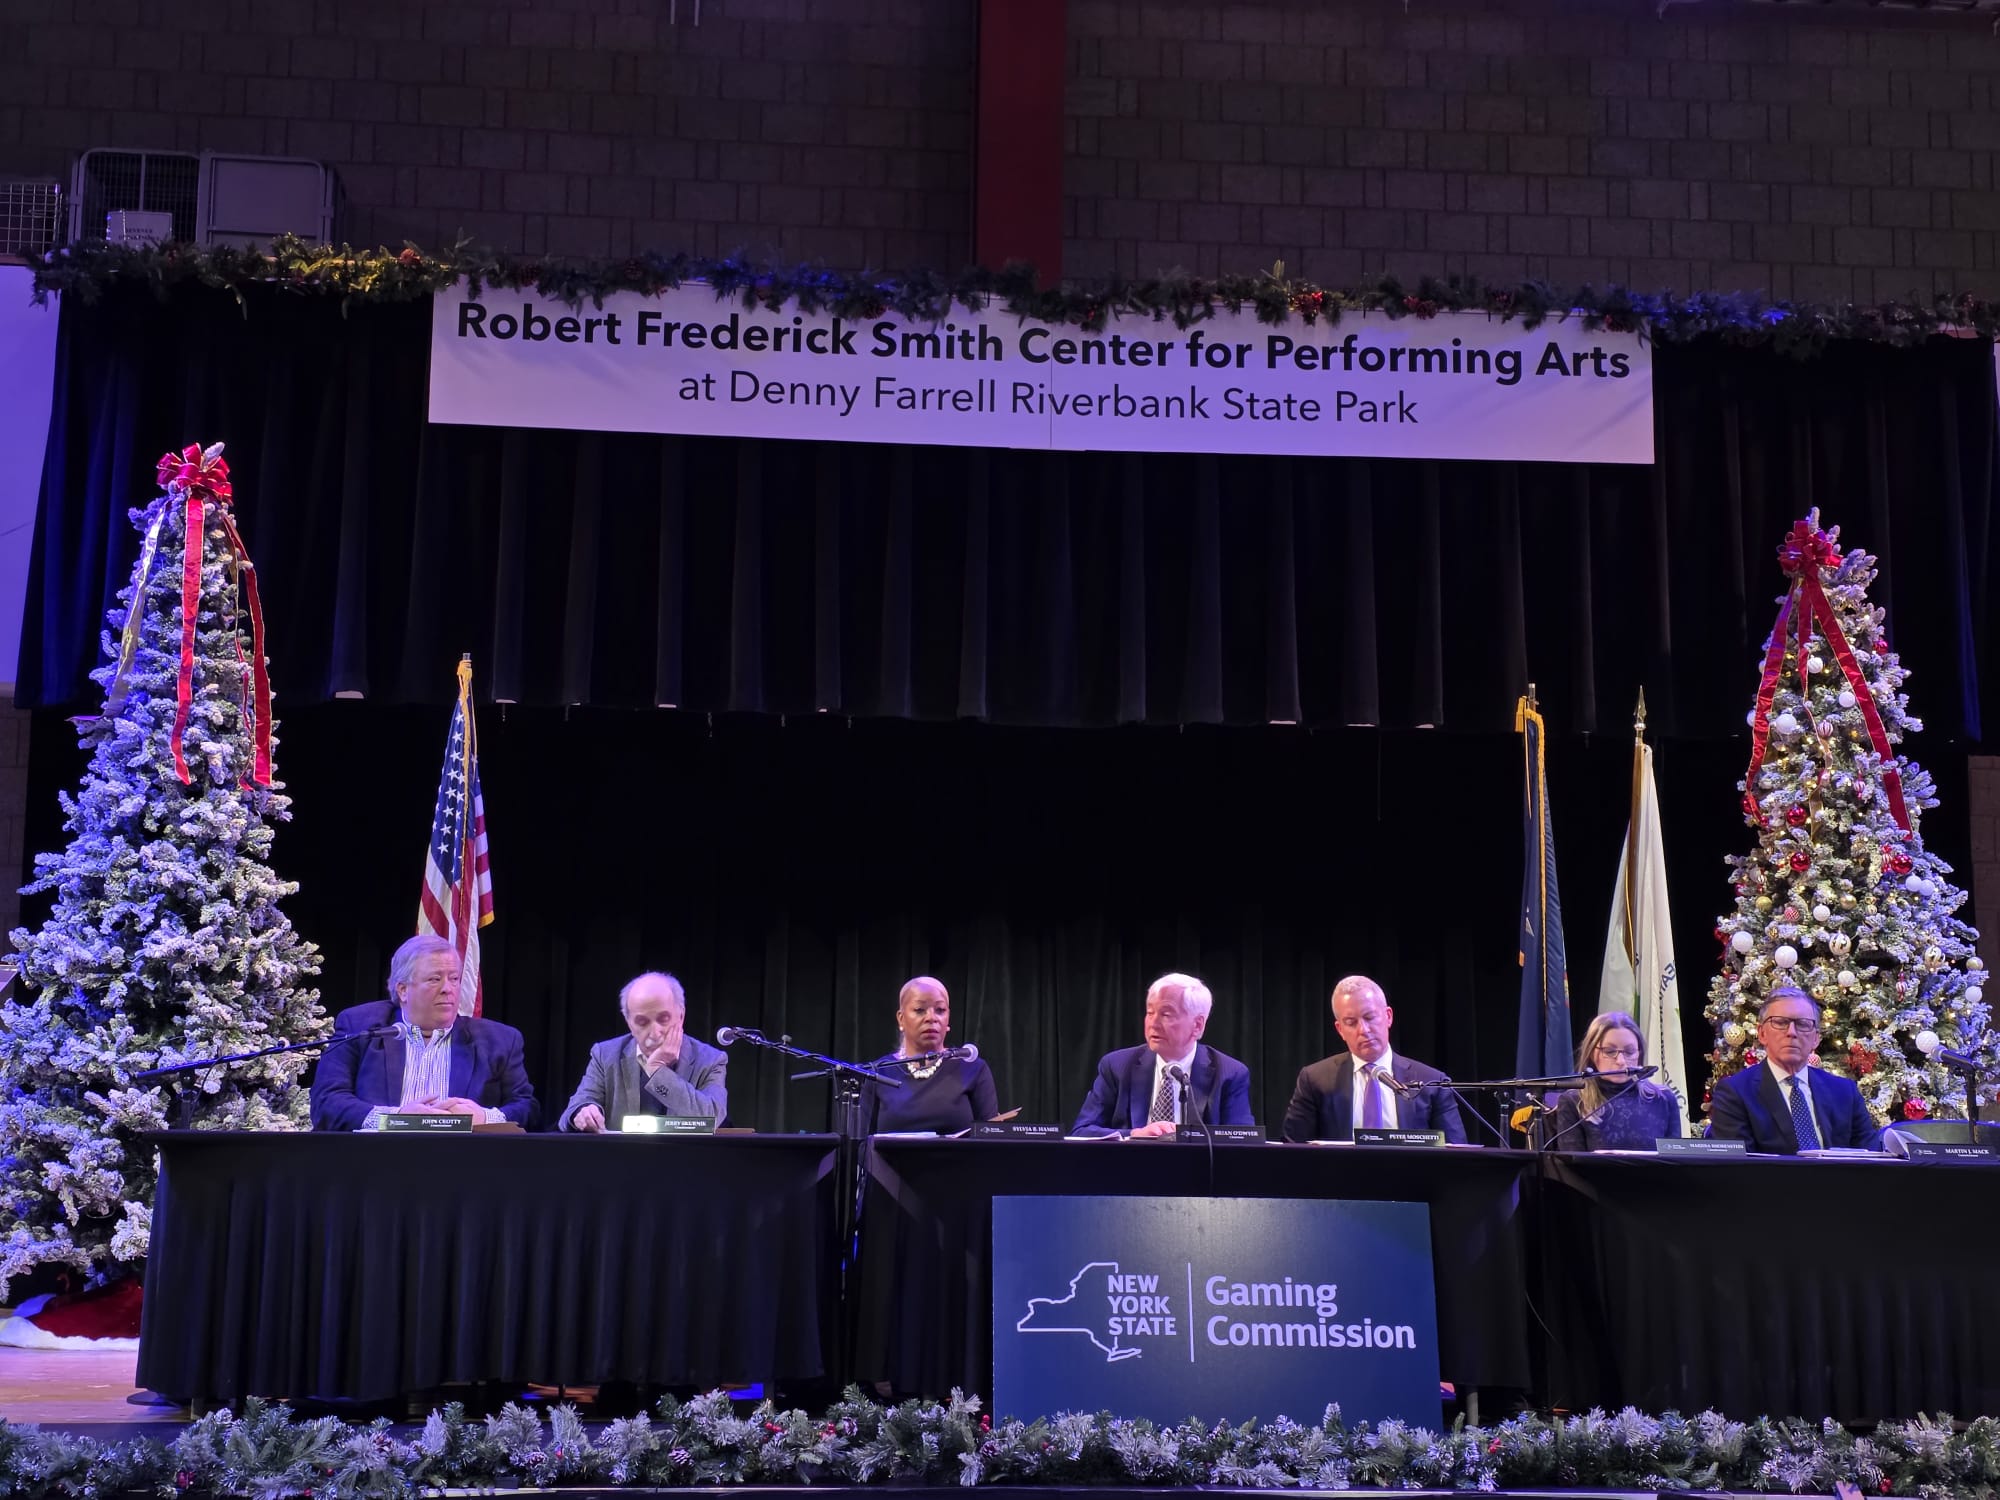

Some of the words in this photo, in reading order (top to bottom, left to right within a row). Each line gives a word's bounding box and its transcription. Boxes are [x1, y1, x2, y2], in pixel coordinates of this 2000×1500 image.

[458, 301, 622, 345] Robert
[637, 311, 856, 356] Frederick
[870, 322, 1004, 361] Smith
[1018, 328, 1175, 366] Center
[1186, 331, 1253, 369] for
[1267, 334, 1522, 385] Performing
[1535, 341, 1630, 378] Arts
[678, 373, 717, 402] at
[730, 371, 861, 417] Denny
[875, 377, 995, 412] Farrell
[1012, 382, 1210, 419] Riverbank
[1223, 388, 1321, 422] State
[1336, 390, 1418, 424] Park
[1107, 1274, 1160, 1294] NEW
[1206, 1274, 1338, 1318] Gaming
[1107, 1295, 1172, 1315] YORK
[1108, 1316, 1177, 1336] STATE
[1206, 1315, 1417, 1349] Commission
